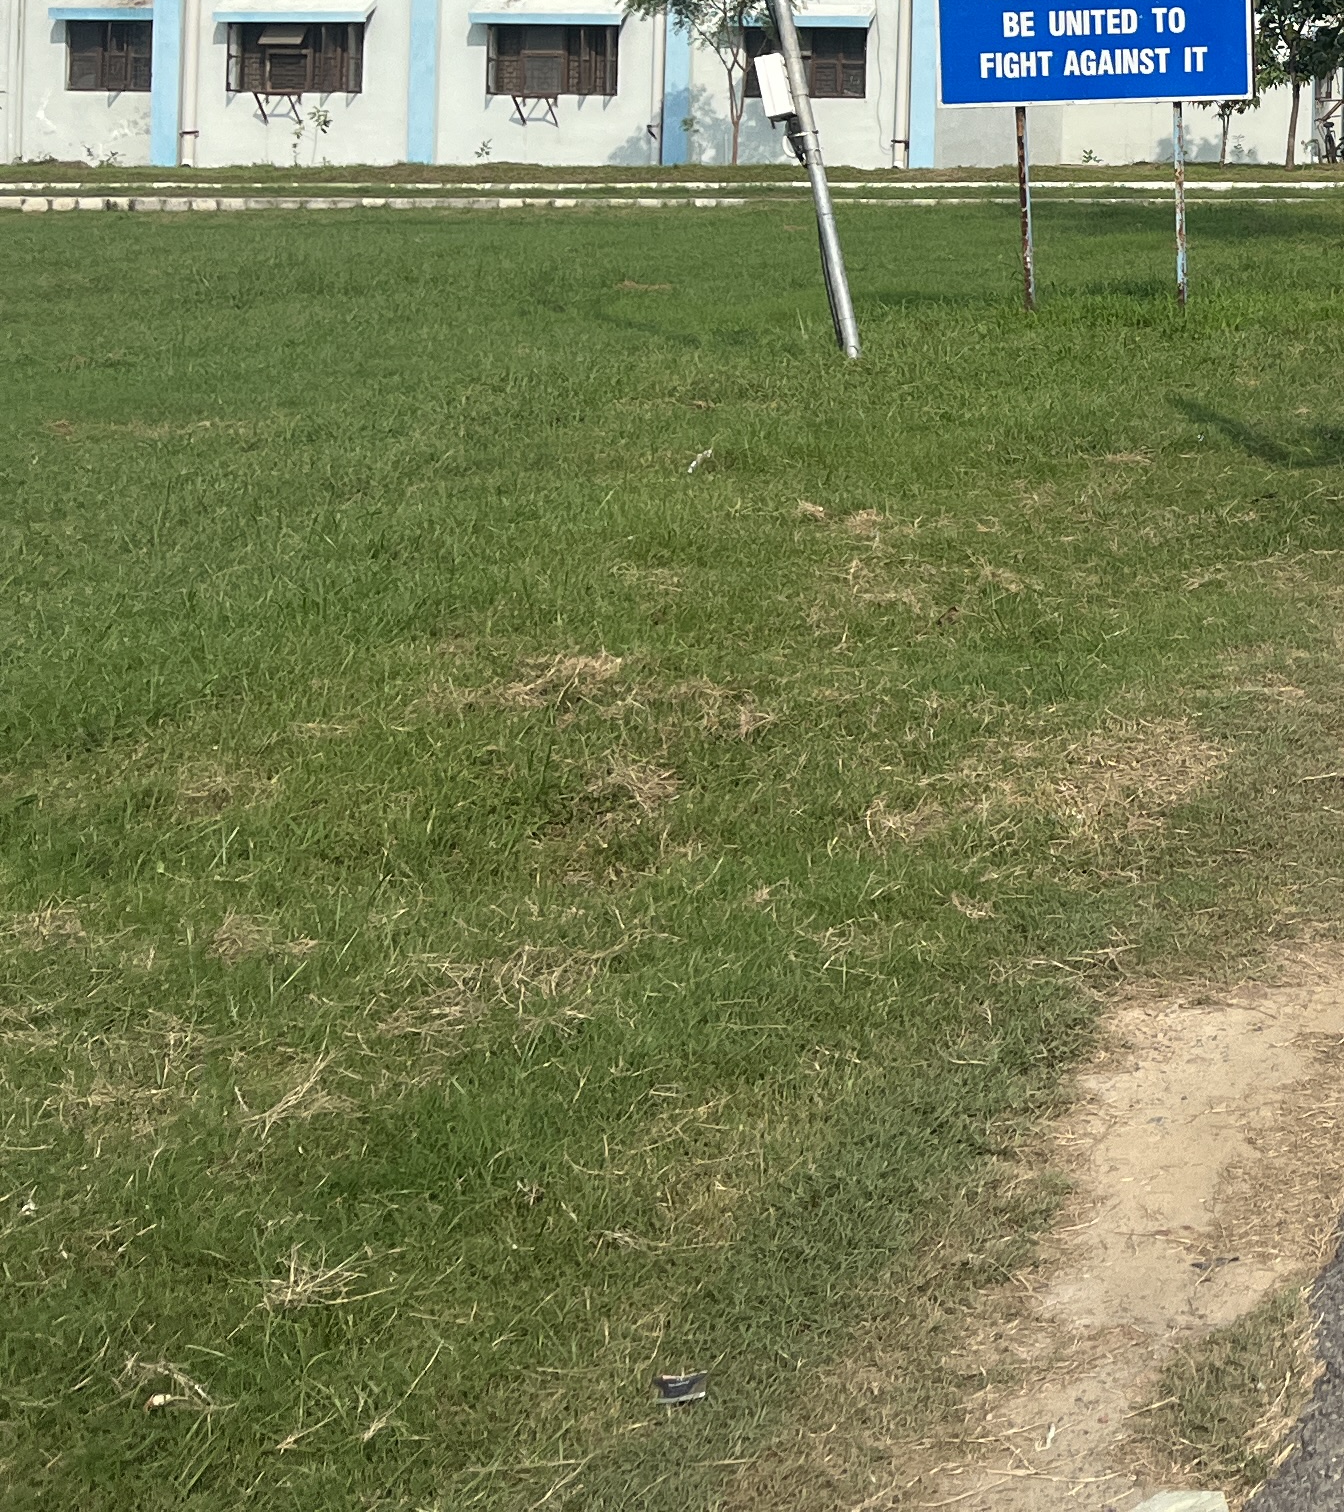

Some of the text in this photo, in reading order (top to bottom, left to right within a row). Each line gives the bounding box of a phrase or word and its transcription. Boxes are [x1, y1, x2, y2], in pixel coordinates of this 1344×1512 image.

[1003, 7, 1185, 37] BE UNITED TO
[981, 47, 1207, 78] FIGHT AGAINST IT
